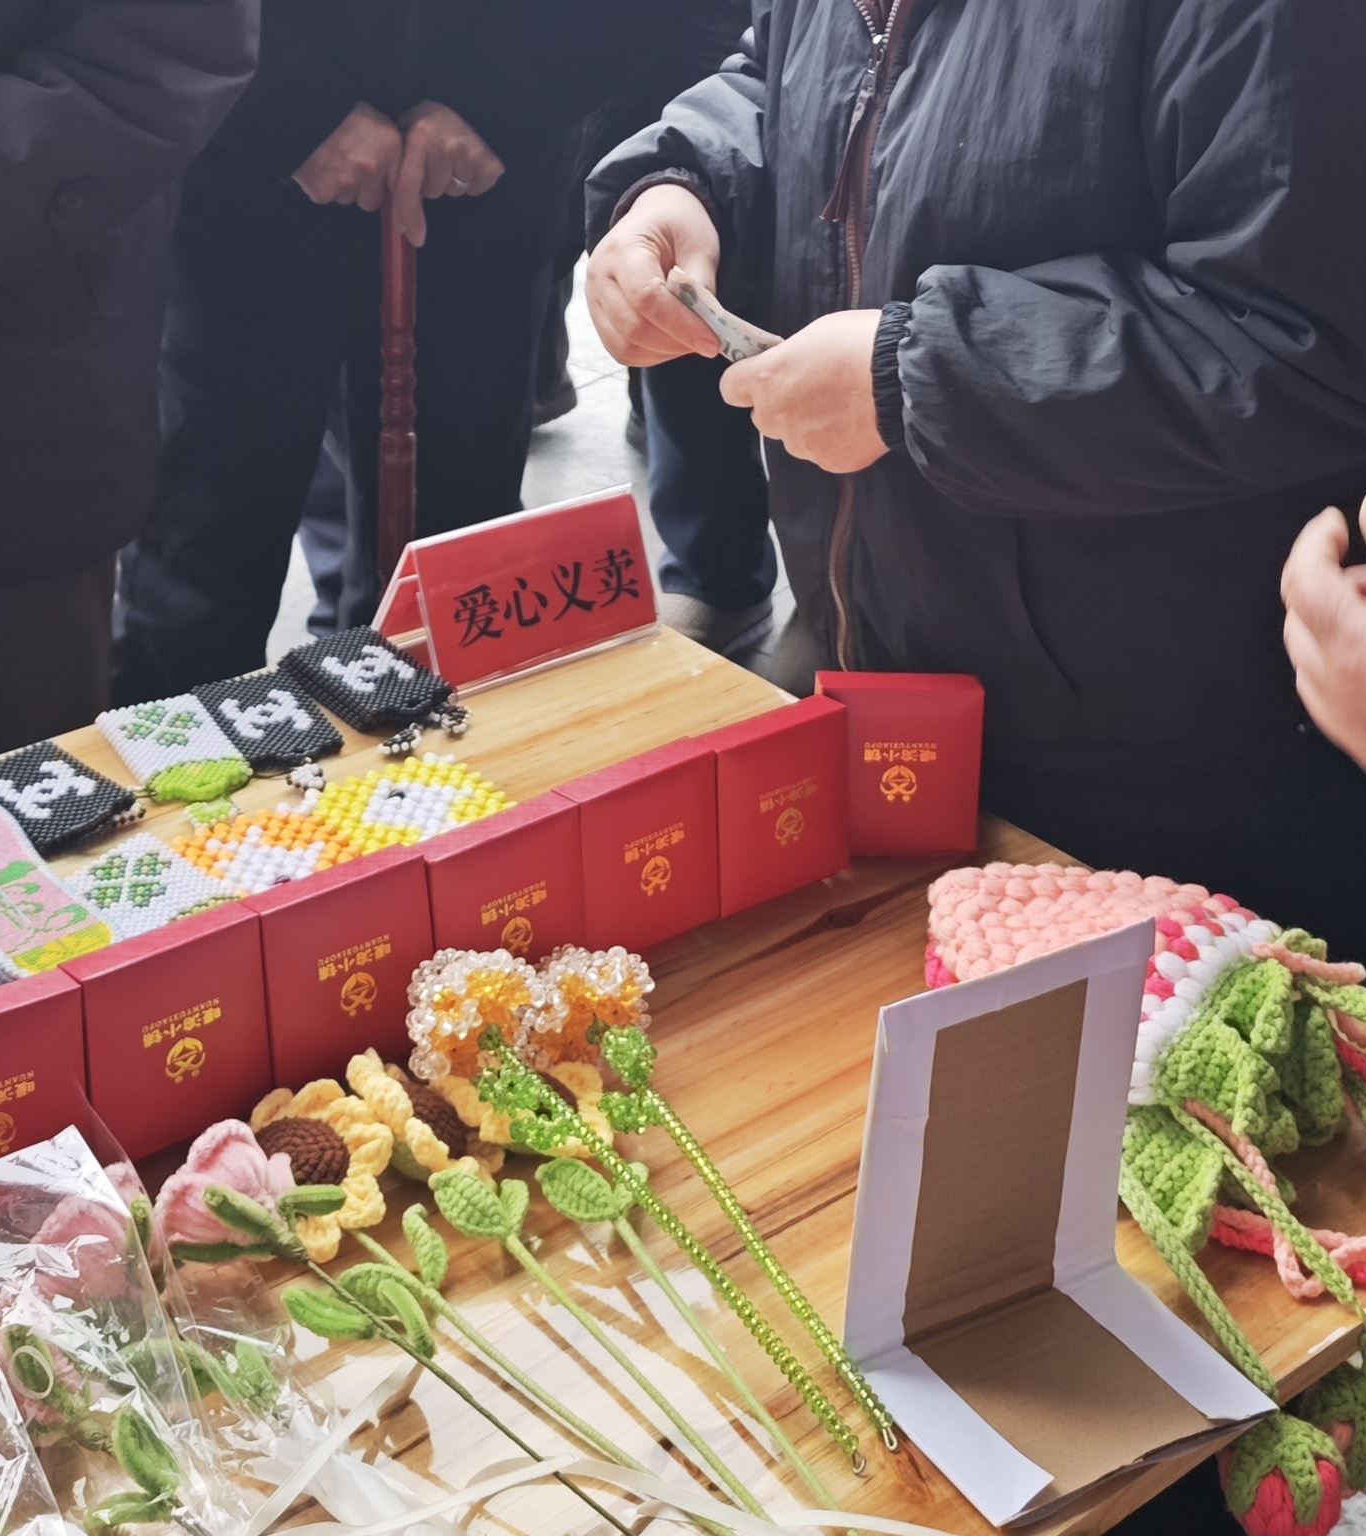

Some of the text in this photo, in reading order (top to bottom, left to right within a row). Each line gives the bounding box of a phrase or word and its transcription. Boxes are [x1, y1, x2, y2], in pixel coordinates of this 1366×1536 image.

[453, 548, 640, 648] 爱心义卖
[318, 942, 392, 982] 暖渝小铺
[142, 1005, 222, 1049] 暖渝小铺
